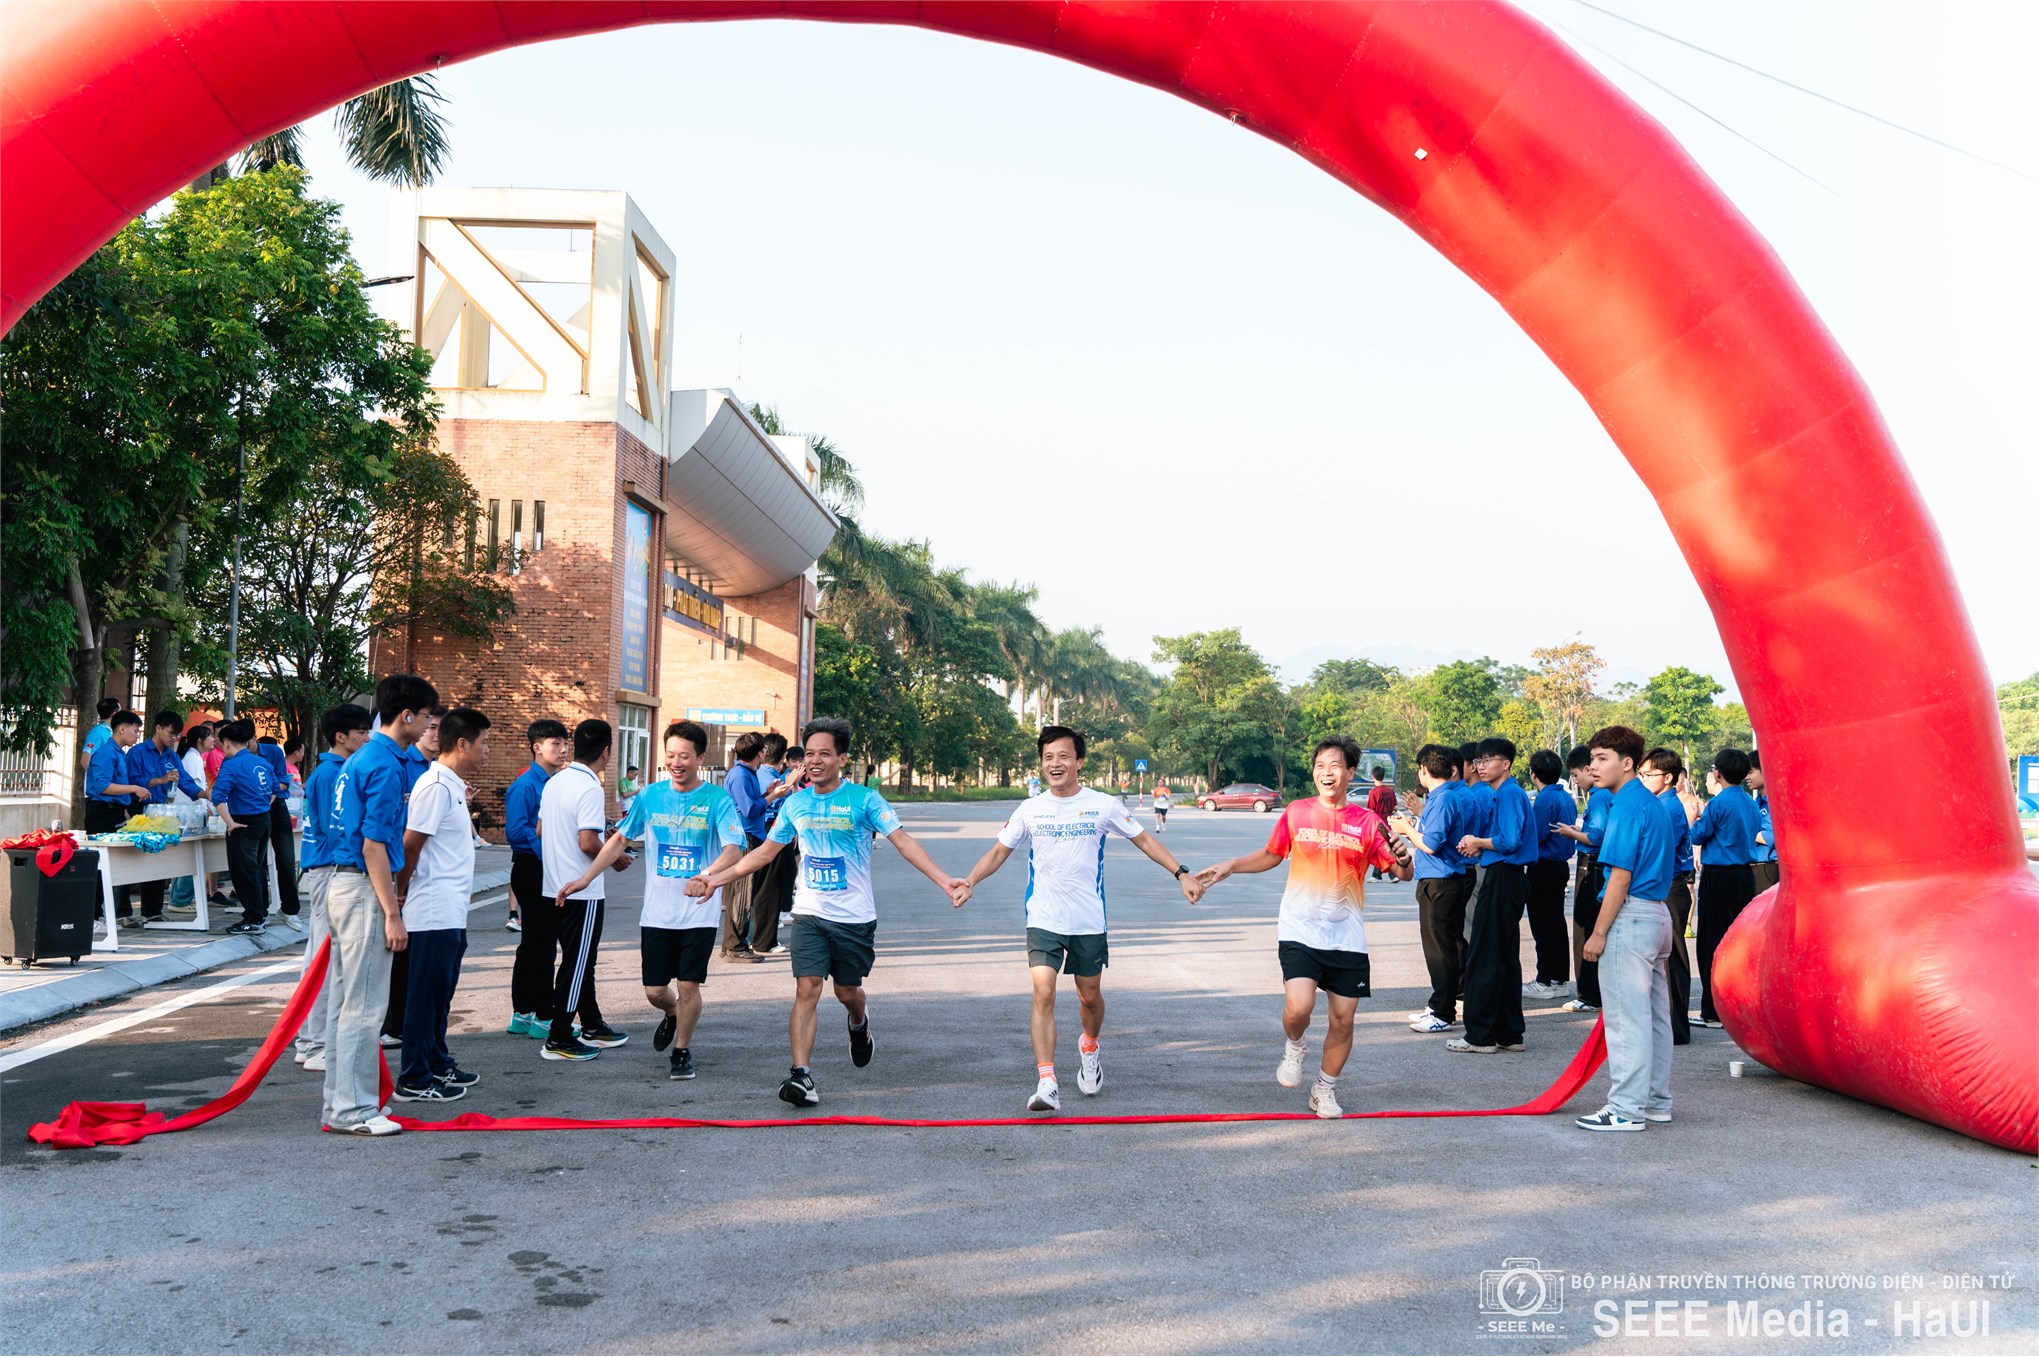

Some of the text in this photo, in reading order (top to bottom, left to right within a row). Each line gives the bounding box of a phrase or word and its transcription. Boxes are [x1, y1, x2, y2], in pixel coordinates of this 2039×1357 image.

[836, 805, 851, 813] HaUI
[1065, 822, 1096, 830] ELECTRICAL
[1066, 828, 1097, 837] ENGINEERING
[663, 856, 695, 871] 5031
[808, 867, 839, 883] 5015
